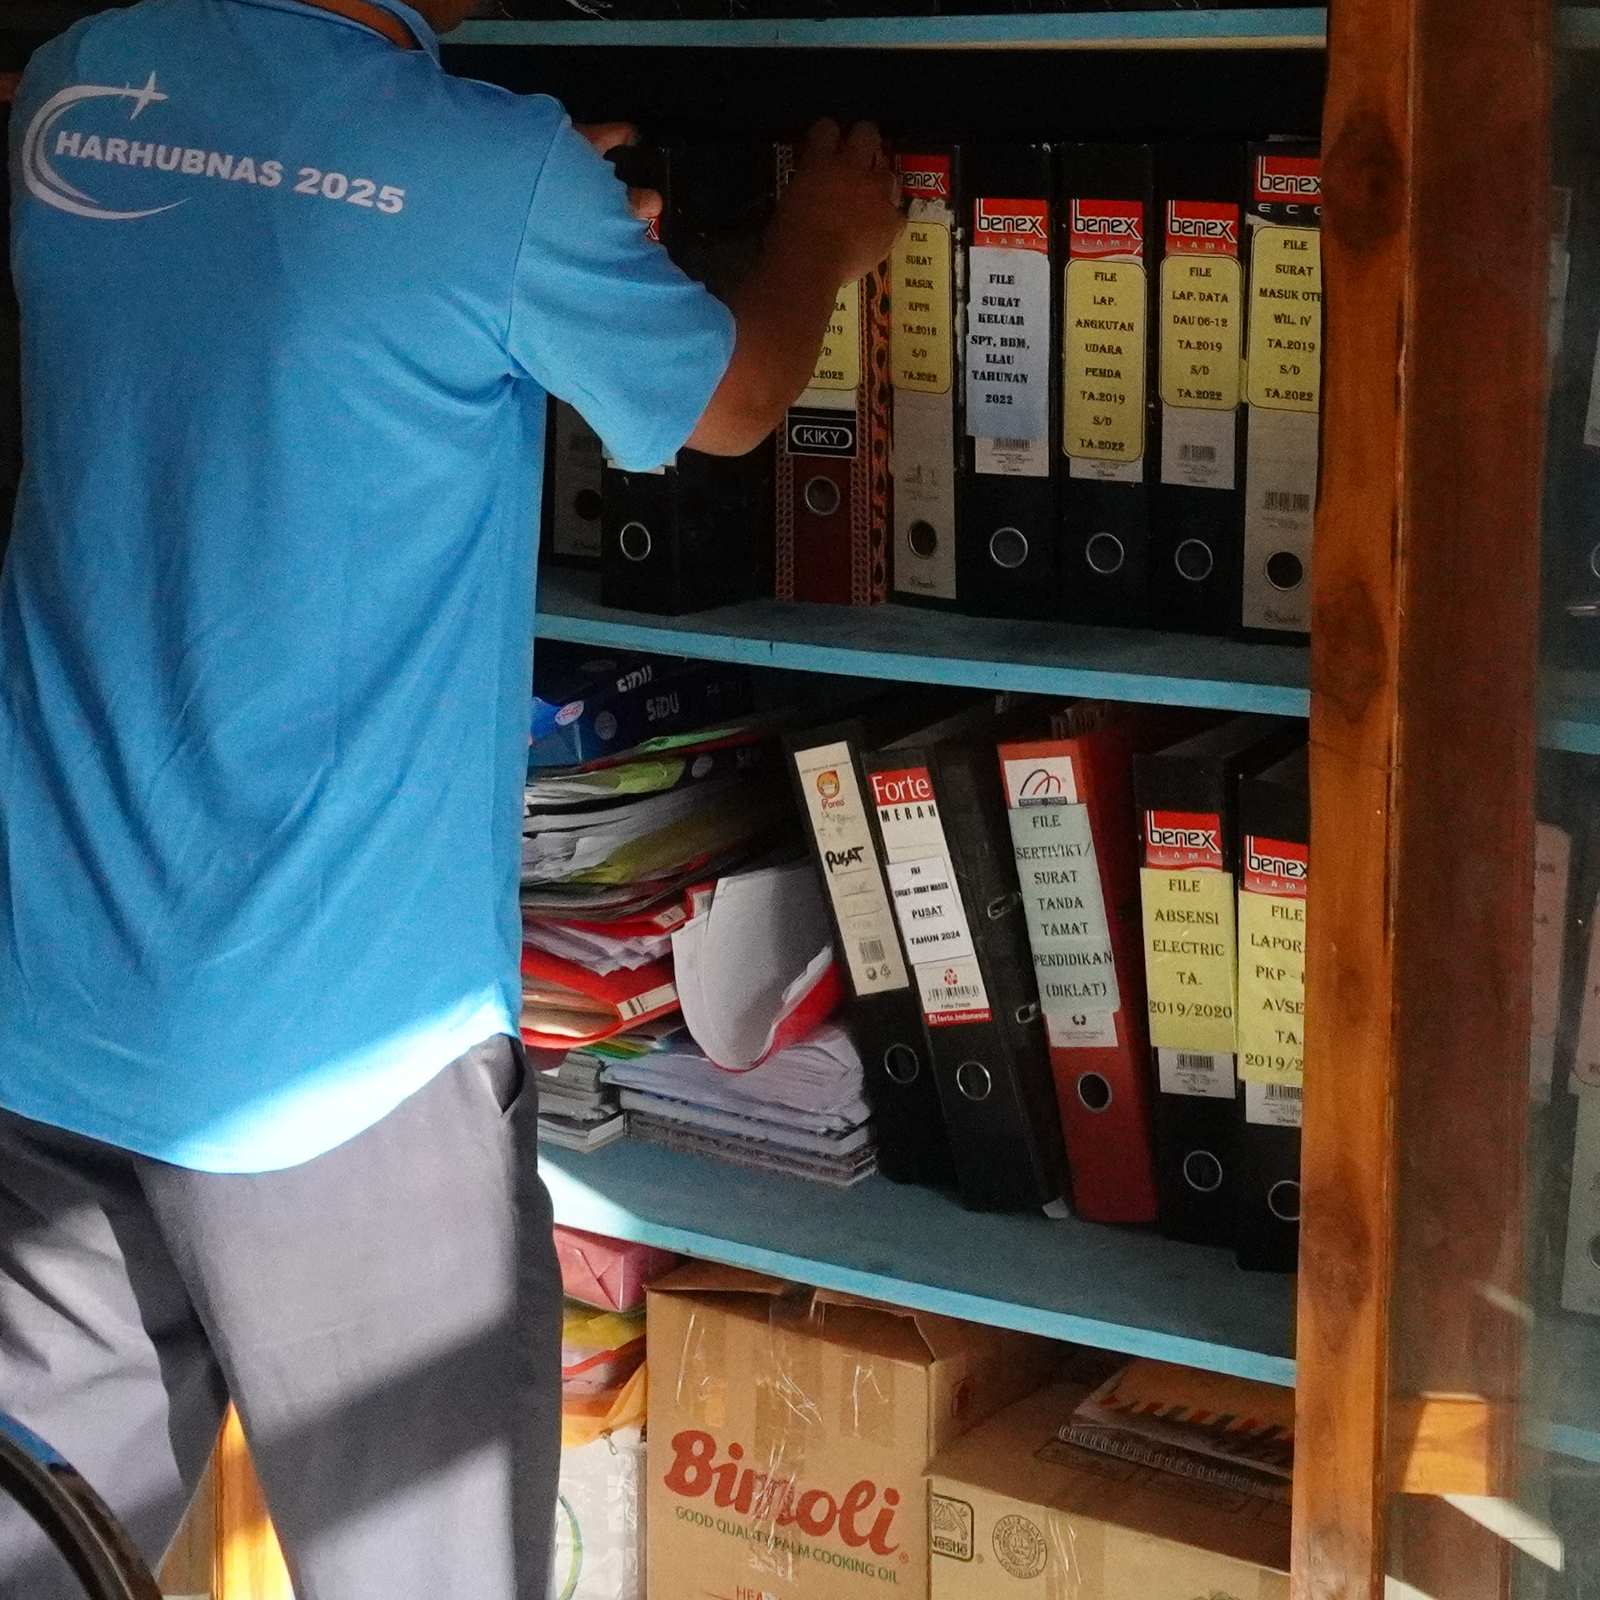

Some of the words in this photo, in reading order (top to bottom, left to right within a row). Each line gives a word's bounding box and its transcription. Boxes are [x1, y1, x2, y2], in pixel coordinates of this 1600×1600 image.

[54, 131, 284, 187] HARHUBNAS
[294, 168, 405, 214] 2025
[976, 198, 1047, 238] benex
[1072, 198, 1143, 240] benex
[1168, 200, 1237, 244] benex
[911, 232, 928, 242] FILE
[1283, 240, 1308, 250] FILE
[905, 255, 932, 266] SURAT
[1094, 272, 1117, 282] FILE
[1190, 267, 1212, 278] FILE
[1275, 265, 1313, 276] SURAT
[905, 278, 934, 289] MASUK
[989, 274, 1014, 285] FILE
[1172, 291, 1198, 301] LAP.
[1199, 292, 1228, 303] DATA
[1260, 288, 1299, 300] MASUK
[982, 296, 1020, 308] SURAT
[1093, 296, 1117, 306] LAP.
[978, 313, 1024, 326] KELUAR
[1075, 319, 1134, 332] ANGKUTAN
[1173, 316, 1196, 326] DAU
[1197, 317, 1228, 328] 06-12
[1274, 313, 1296, 325] WIL.
[1300, 315, 1312, 326] IV
[1085, 344, 1122, 355] UDARA
[1178, 339, 1222, 352] TA.2019
[1268, 339, 1315, 352] TA.2019
[912, 349, 927, 359] S/D
[986, 354, 1014, 365] LLAU
[1085, 368, 1121, 379] PEMDA
[1191, 365, 1209, 375] S/D
[1280, 365, 1300, 375] S/D
[972, 370, 1028, 384] TAHUNAN
[985, 394, 1013, 404] 2022
[1080, 390, 1125, 404] TA.2019
[1177, 389, 1223, 400] TA.2022
[1265, 388, 1313, 401] TA.2022
[1093, 415, 1112, 426] S/D
[803, 429, 841, 444] KIKY
[1079, 438, 1125, 451] TA.2022
[871, 776, 930, 803] Forte
[881, 804, 936, 822] MERAH
[1032, 815, 1061, 828] FILE
[1146, 810, 1221, 854] benex
[825, 847, 864, 872] PUSAT
[1034, 870, 1078, 885] SURAT
[1169, 879, 1200, 893] FILE
[1038, 896, 1084, 911] TANDA
[912, 905, 943, 920] PUSAT
[1154, 909, 1220, 925] ABSENSI
[1271, 905, 1304, 922] FILE
[1042, 922, 1089, 936] TAMAT
[909, 934, 939, 945] TAHUN
[941, 930, 960, 941] 2024
[1152, 940, 1225, 956] ELECTRIC
[1033, 950, 1112, 968] PENDIDIKAN
[1176, 972, 1202, 985] TA.
[1255, 965, 1286, 979] PKP
[1045, 982, 1107, 997] (DIKLAT)
[1149, 1003, 1233, 1019] 2019/2020
[1262, 998, 1304, 1014] AVSE
[1275, 1030, 1302, 1045] TA.
[664, 1430, 899, 1555] Bimoli
[674, 1506, 714, 1529] GOOD
[813, 1549, 875, 1577] COOKING
[878, 1568, 897, 1584] OIL
